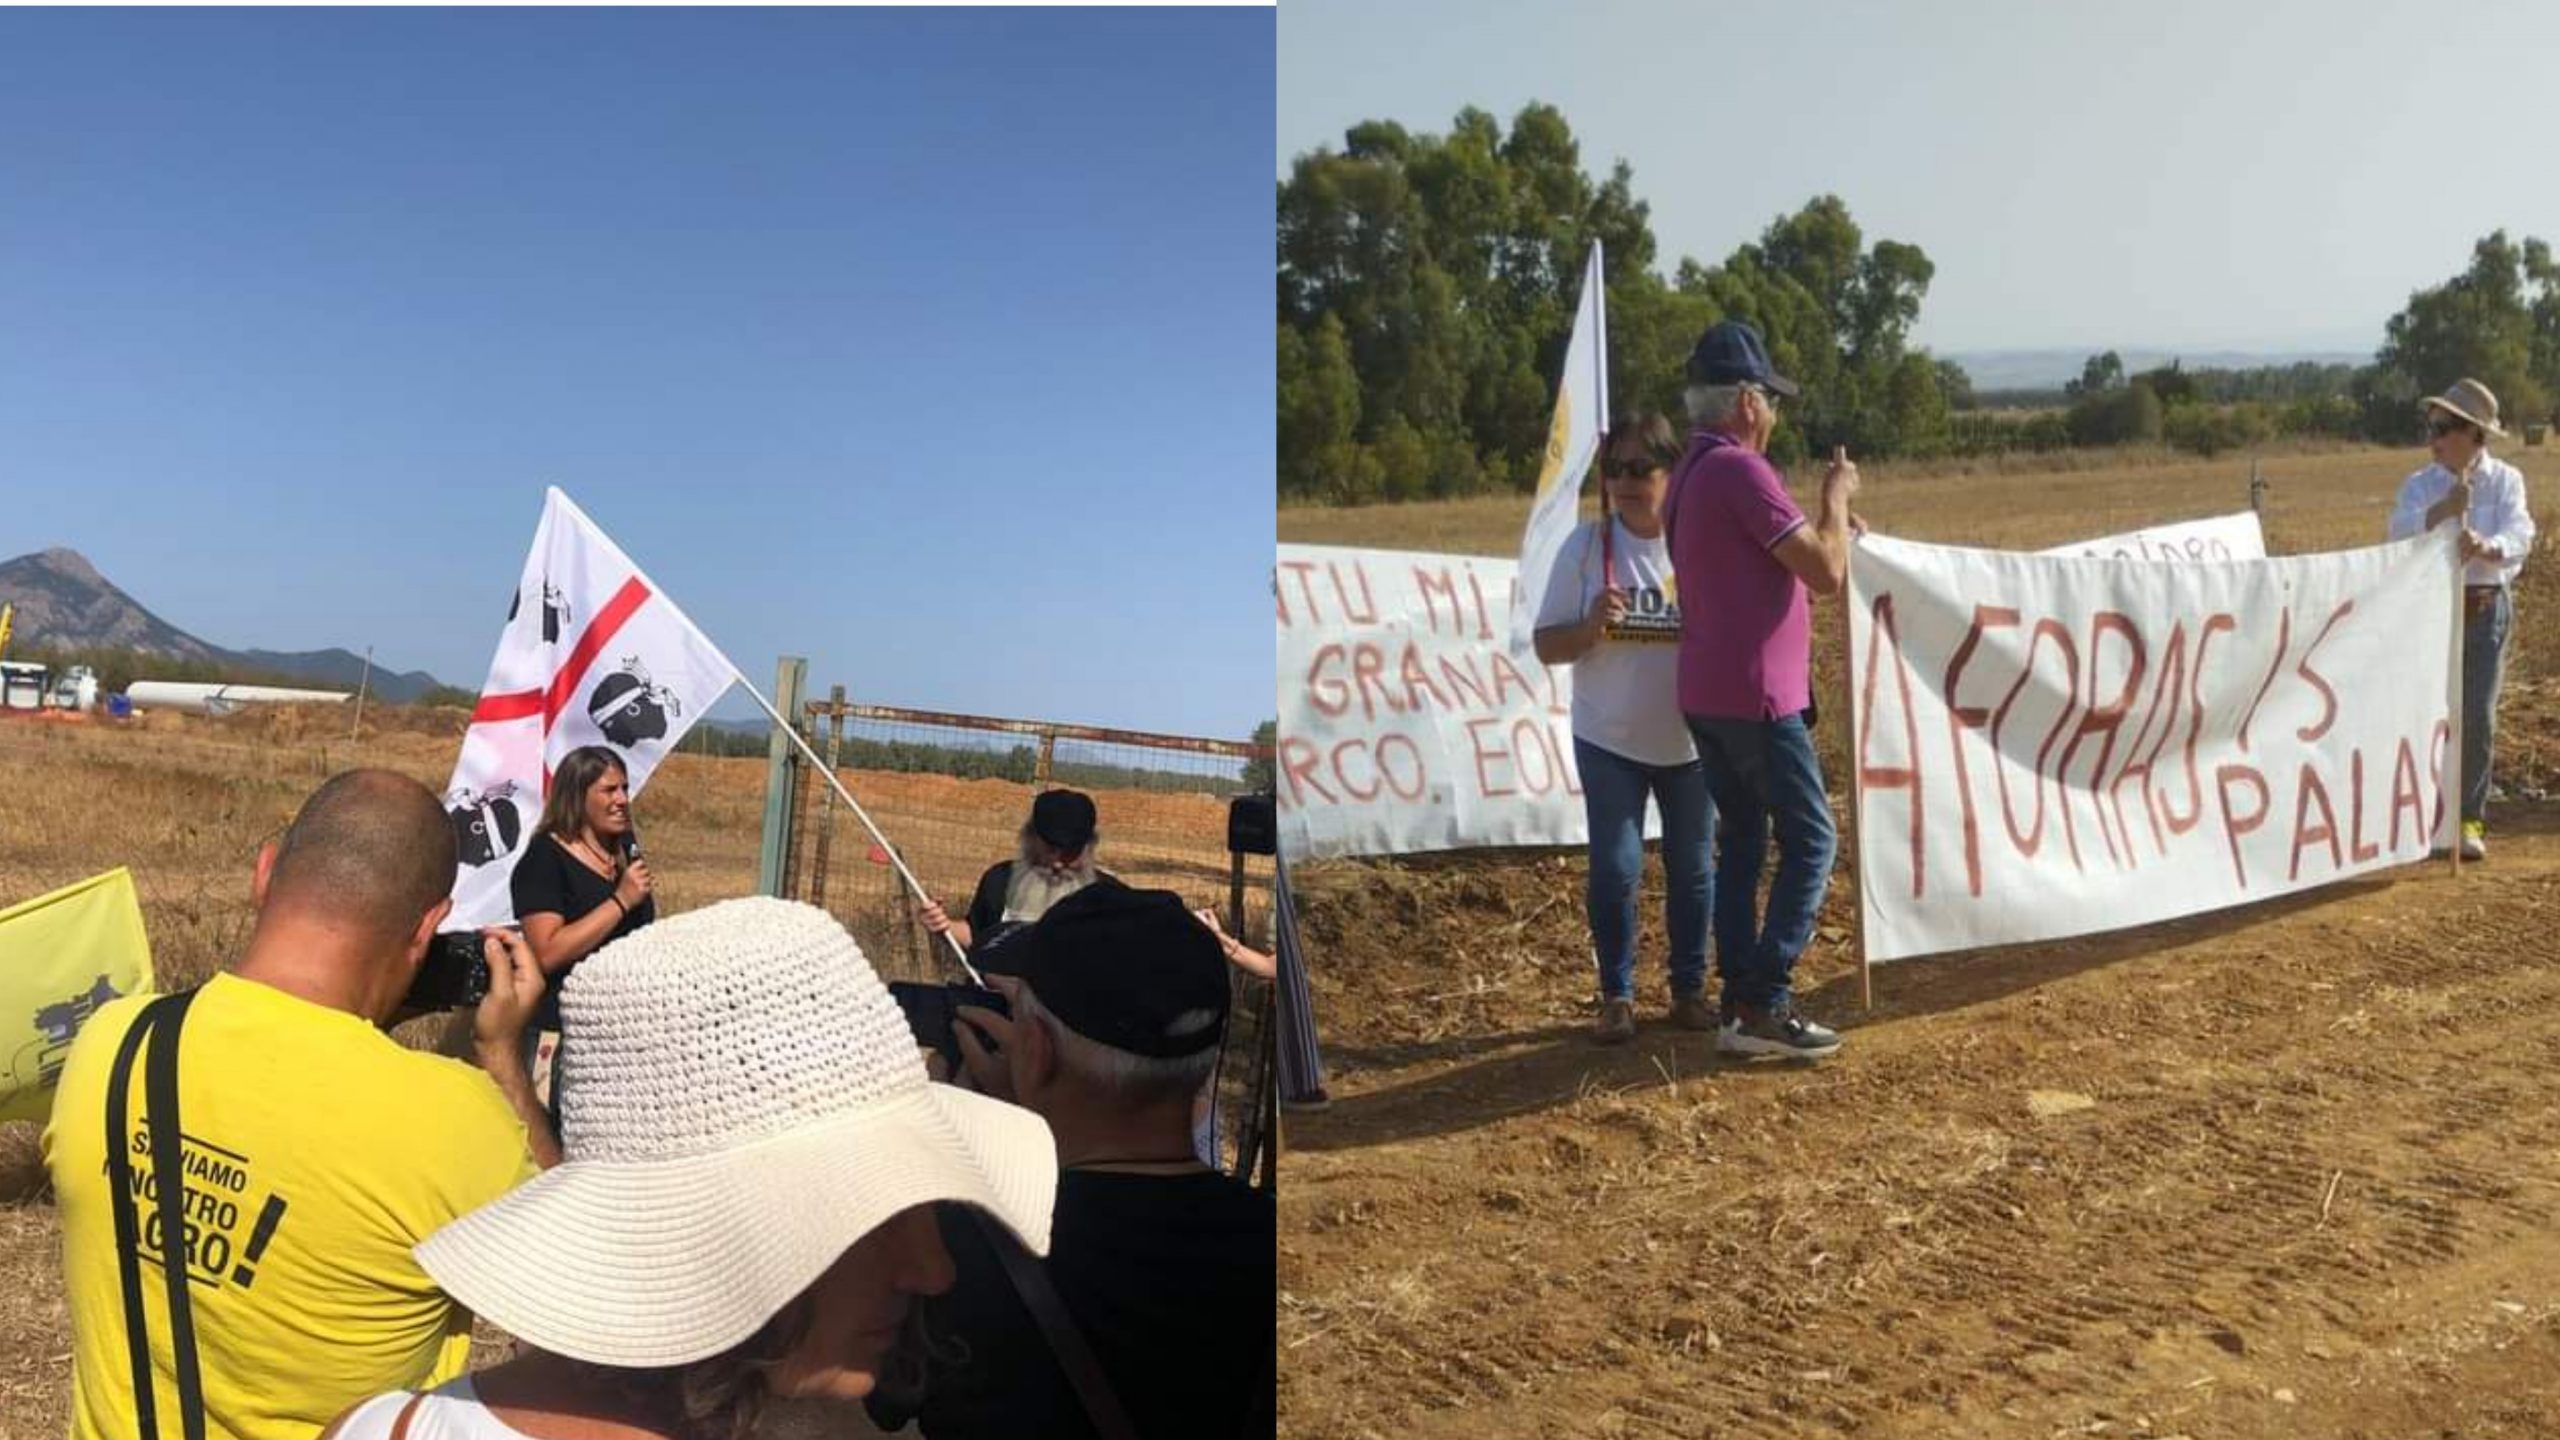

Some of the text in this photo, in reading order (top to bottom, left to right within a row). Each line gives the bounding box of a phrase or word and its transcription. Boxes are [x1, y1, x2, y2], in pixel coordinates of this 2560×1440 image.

[1278, 562, 1396, 631] TU.
[1277, 733, 1442, 810] RCO.
[1861, 593, 1924, 898] A
[1945, 605, 2236, 898] FORAS
[2217, 720, 2449, 888] PALAS
[129, 1165, 238, 1231] NOTRO
[132, 1132, 247, 1193] SVIAMO
